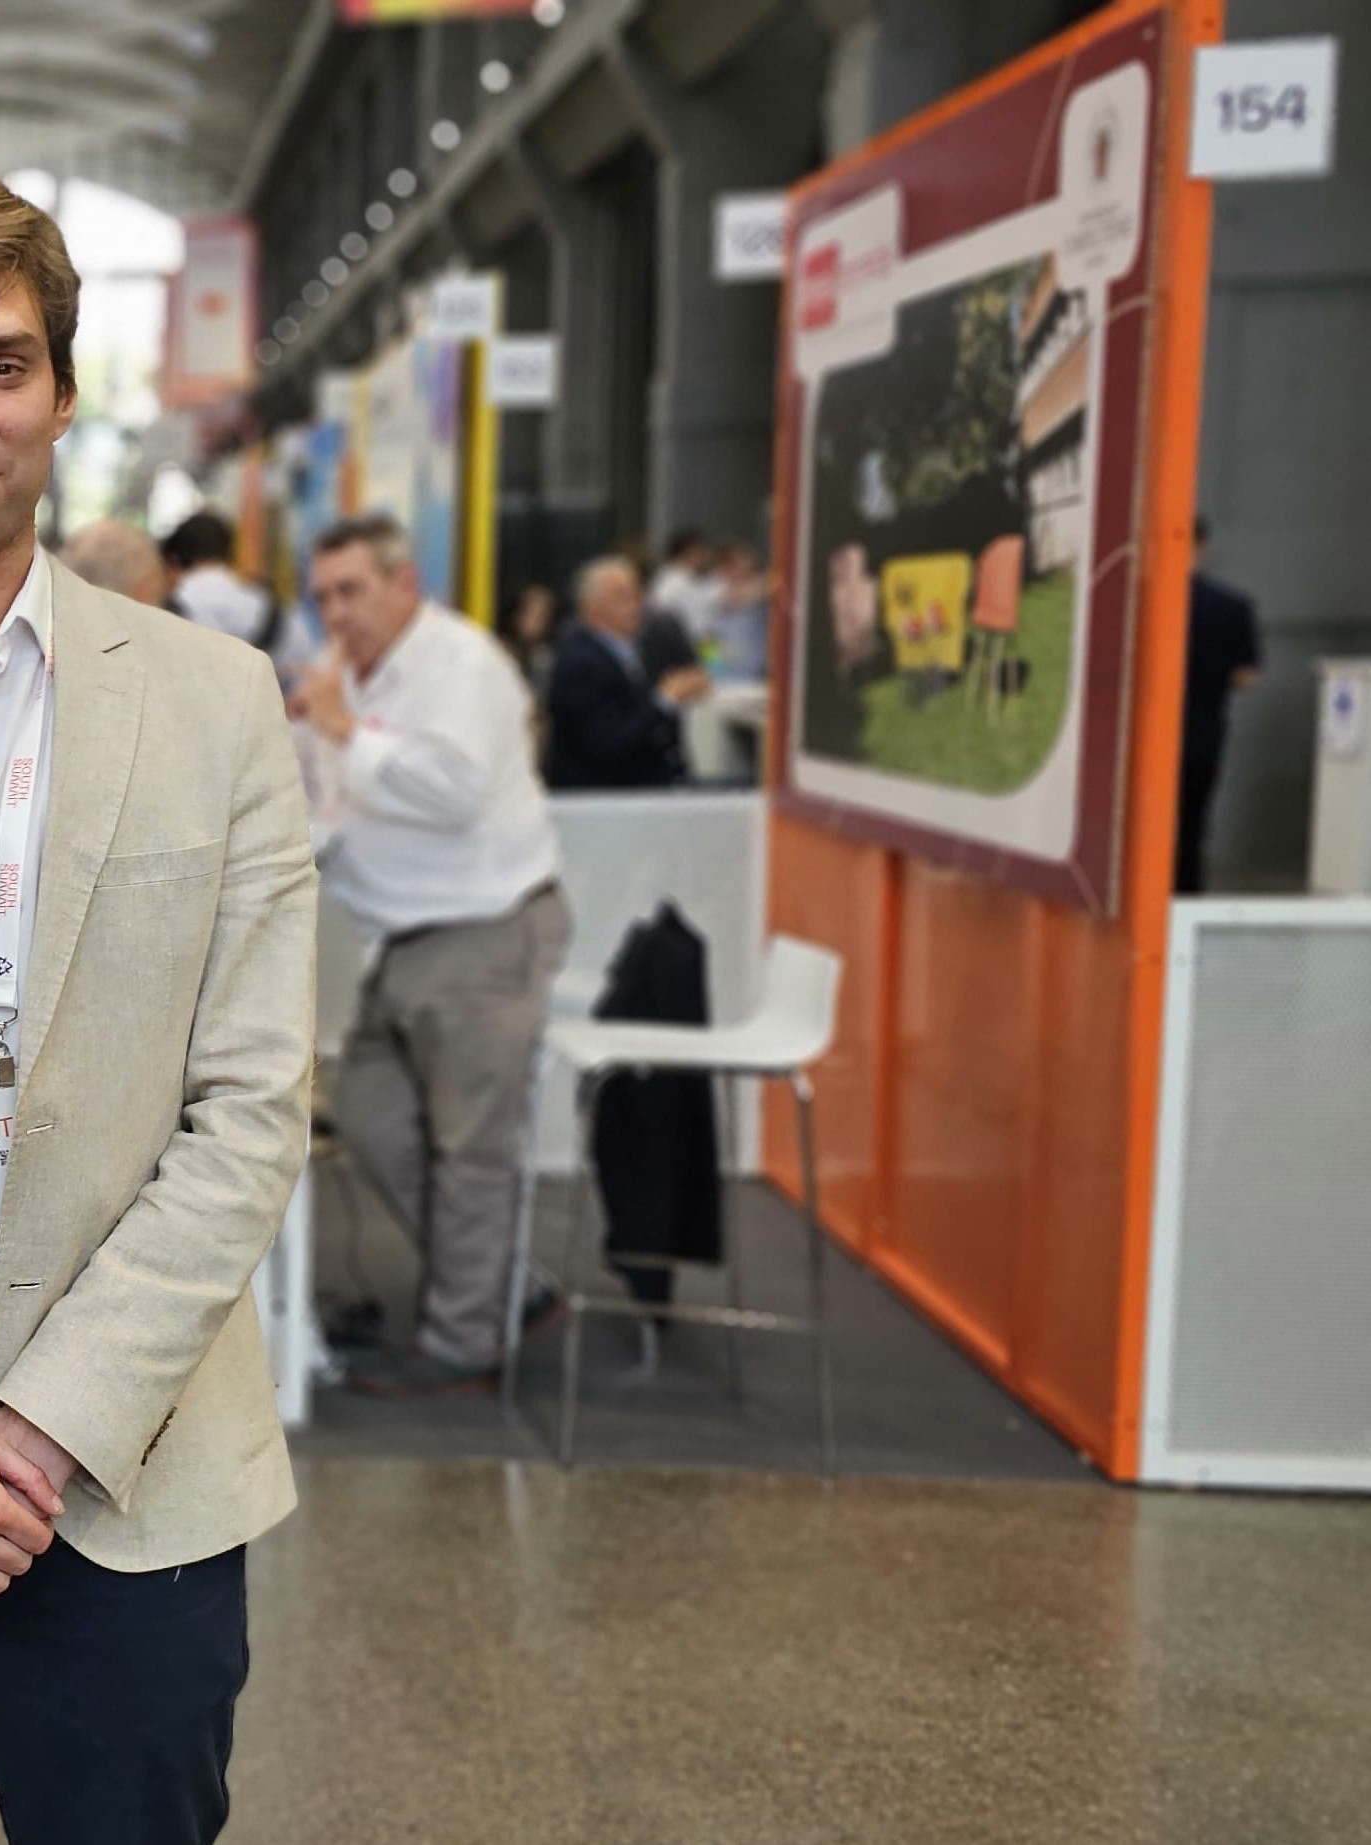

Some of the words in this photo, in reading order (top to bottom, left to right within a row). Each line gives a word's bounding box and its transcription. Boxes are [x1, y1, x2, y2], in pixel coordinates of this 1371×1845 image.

[1216, 84, 1306, 133] 154
[6, 758, 23, 808] SUMMIT
[17, 758, 33, 800] SOUTH
[8, 863, 20, 908] SOUTH
